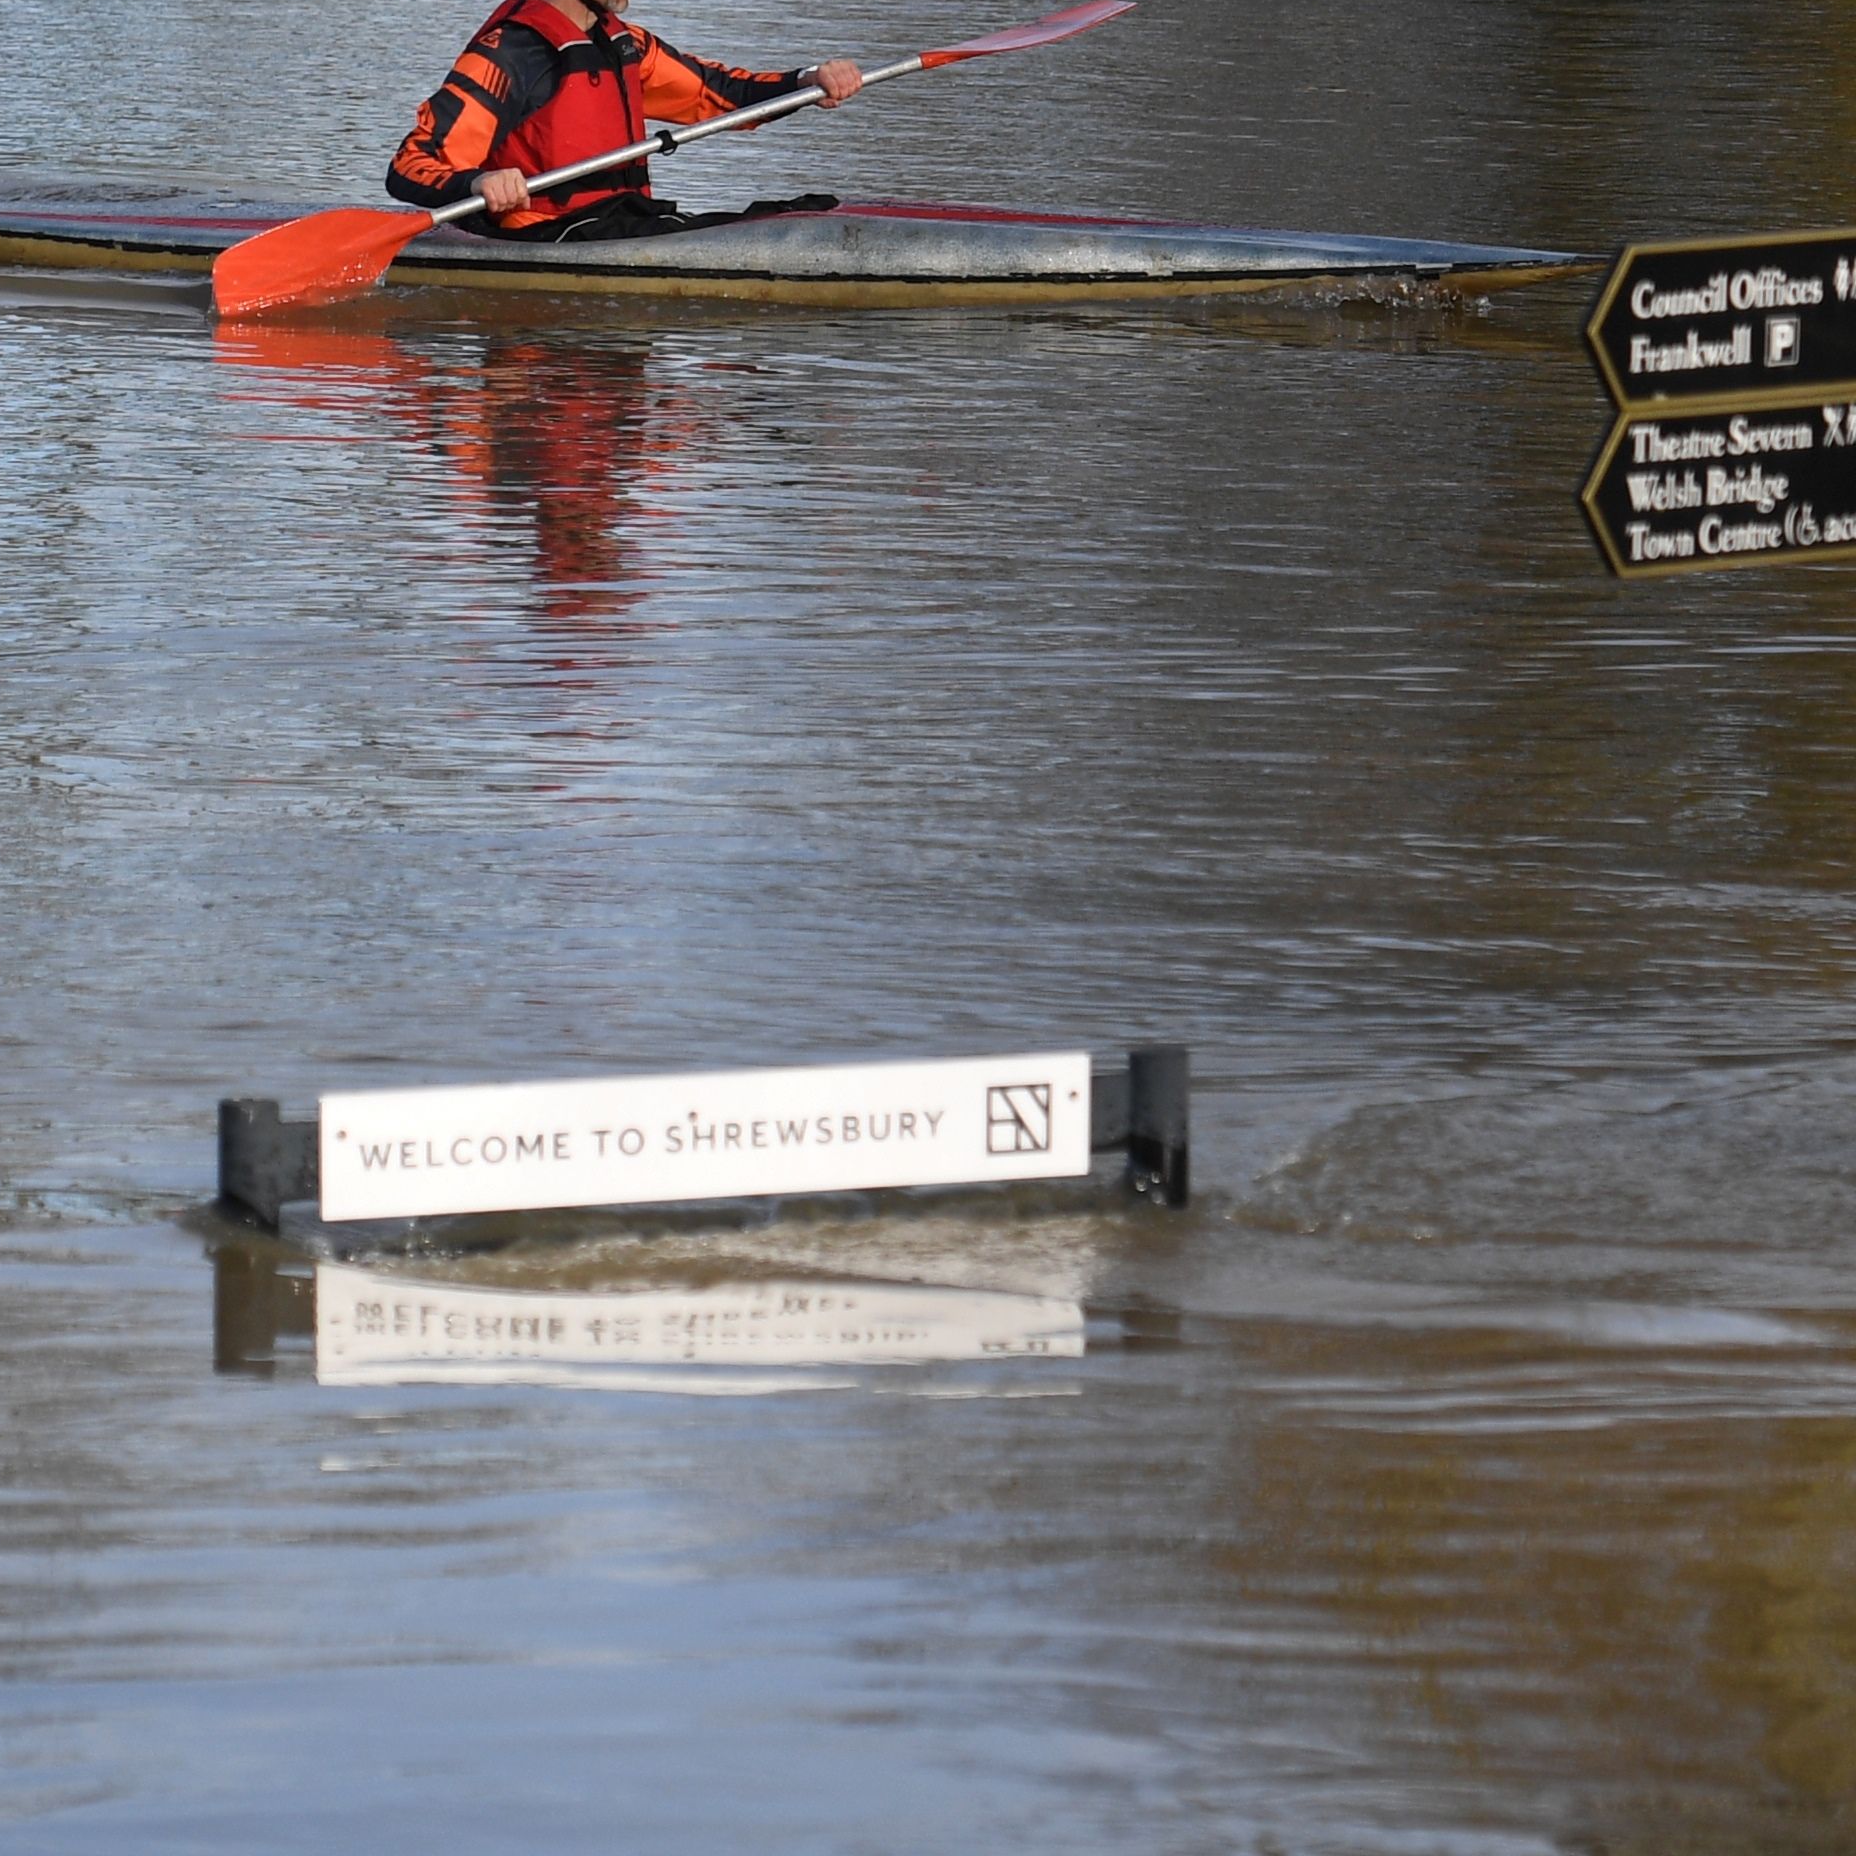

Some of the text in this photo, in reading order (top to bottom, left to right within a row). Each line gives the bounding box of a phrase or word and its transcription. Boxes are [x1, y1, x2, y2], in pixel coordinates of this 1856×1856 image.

[1631, 265, 1824, 318] Council Offices
[1629, 324, 1752, 373] Frankwell
[1629, 415, 1813, 463] Theatre Severn
[1626, 462, 1789, 514] Welsh Bridge
[1626, 521, 1694, 561] Town
[1698, 513, 1783, 554] Centre
[360, 1109, 945, 1172] WELCOME TO SHREWSBURY
